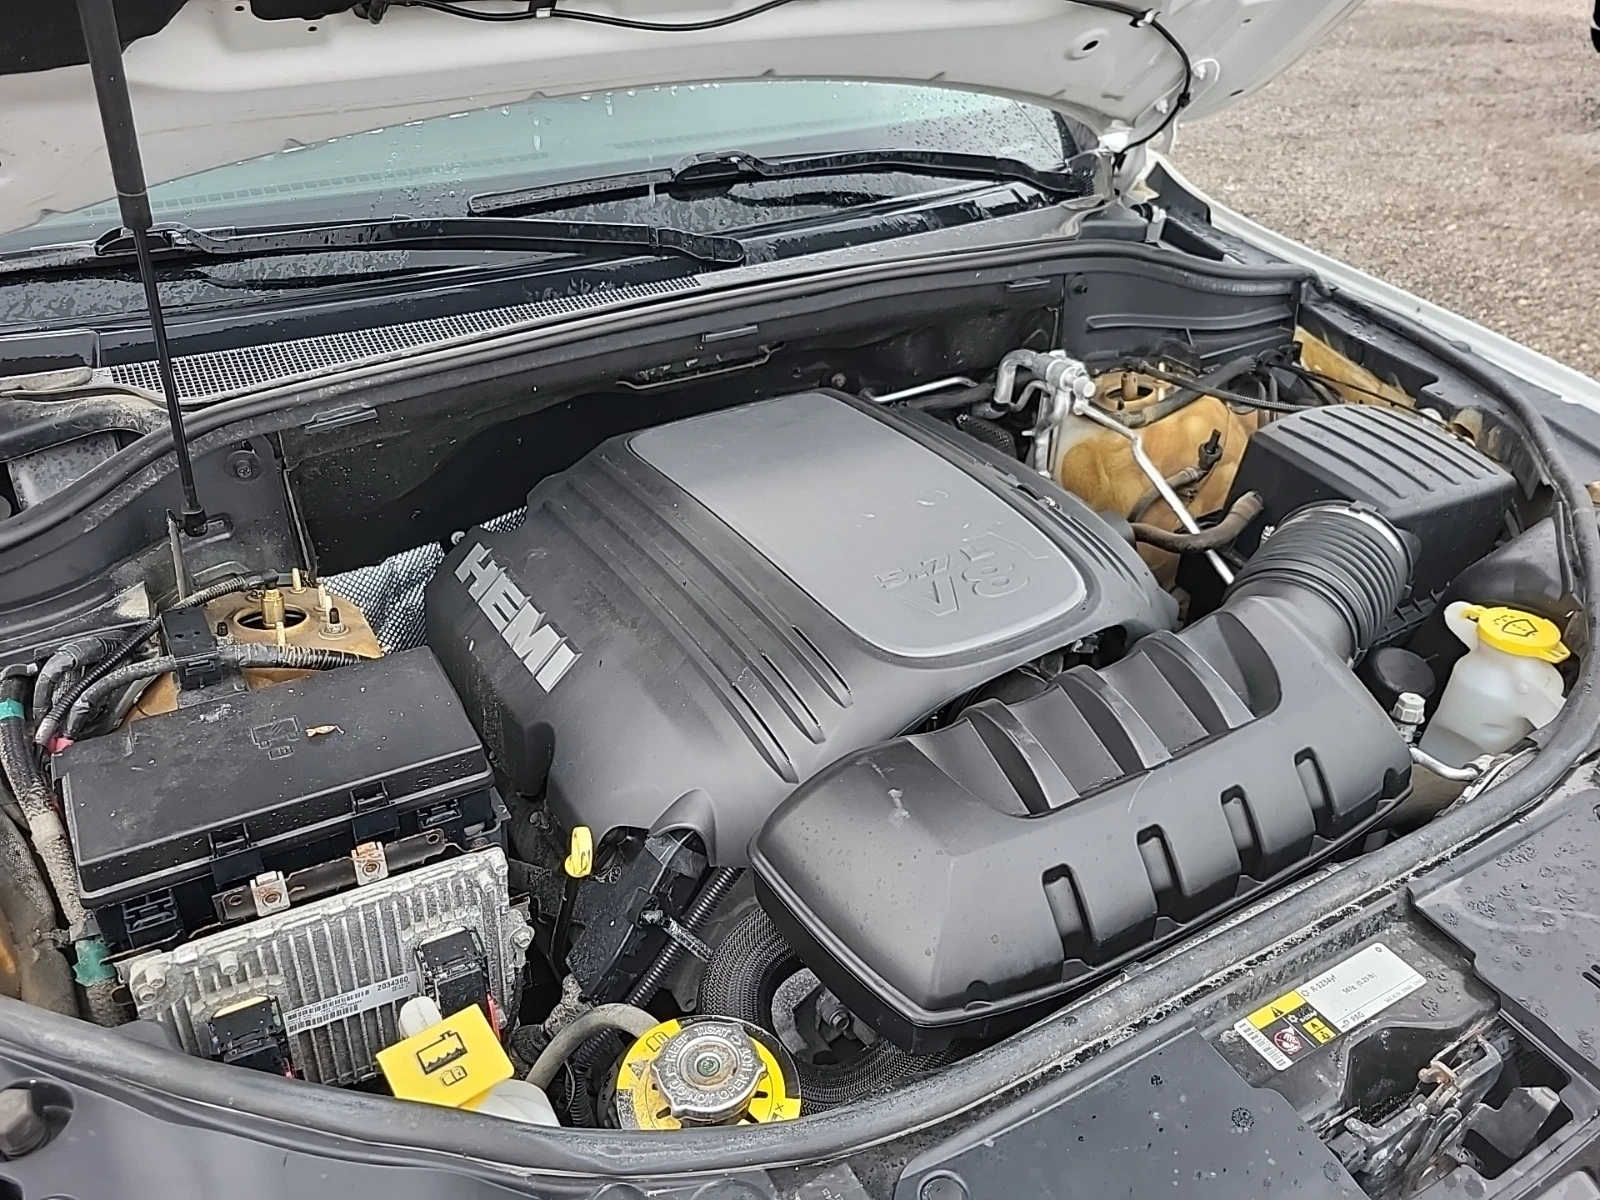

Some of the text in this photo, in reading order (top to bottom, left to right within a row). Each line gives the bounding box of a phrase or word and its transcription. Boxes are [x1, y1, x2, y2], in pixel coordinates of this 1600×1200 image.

[454, 542, 583, 693] HEMI
[1350, 1012, 1365, 1023] PAG
[664, 1033, 690, 1062] KEEP
[718, 1073, 750, 1101] OPEN
